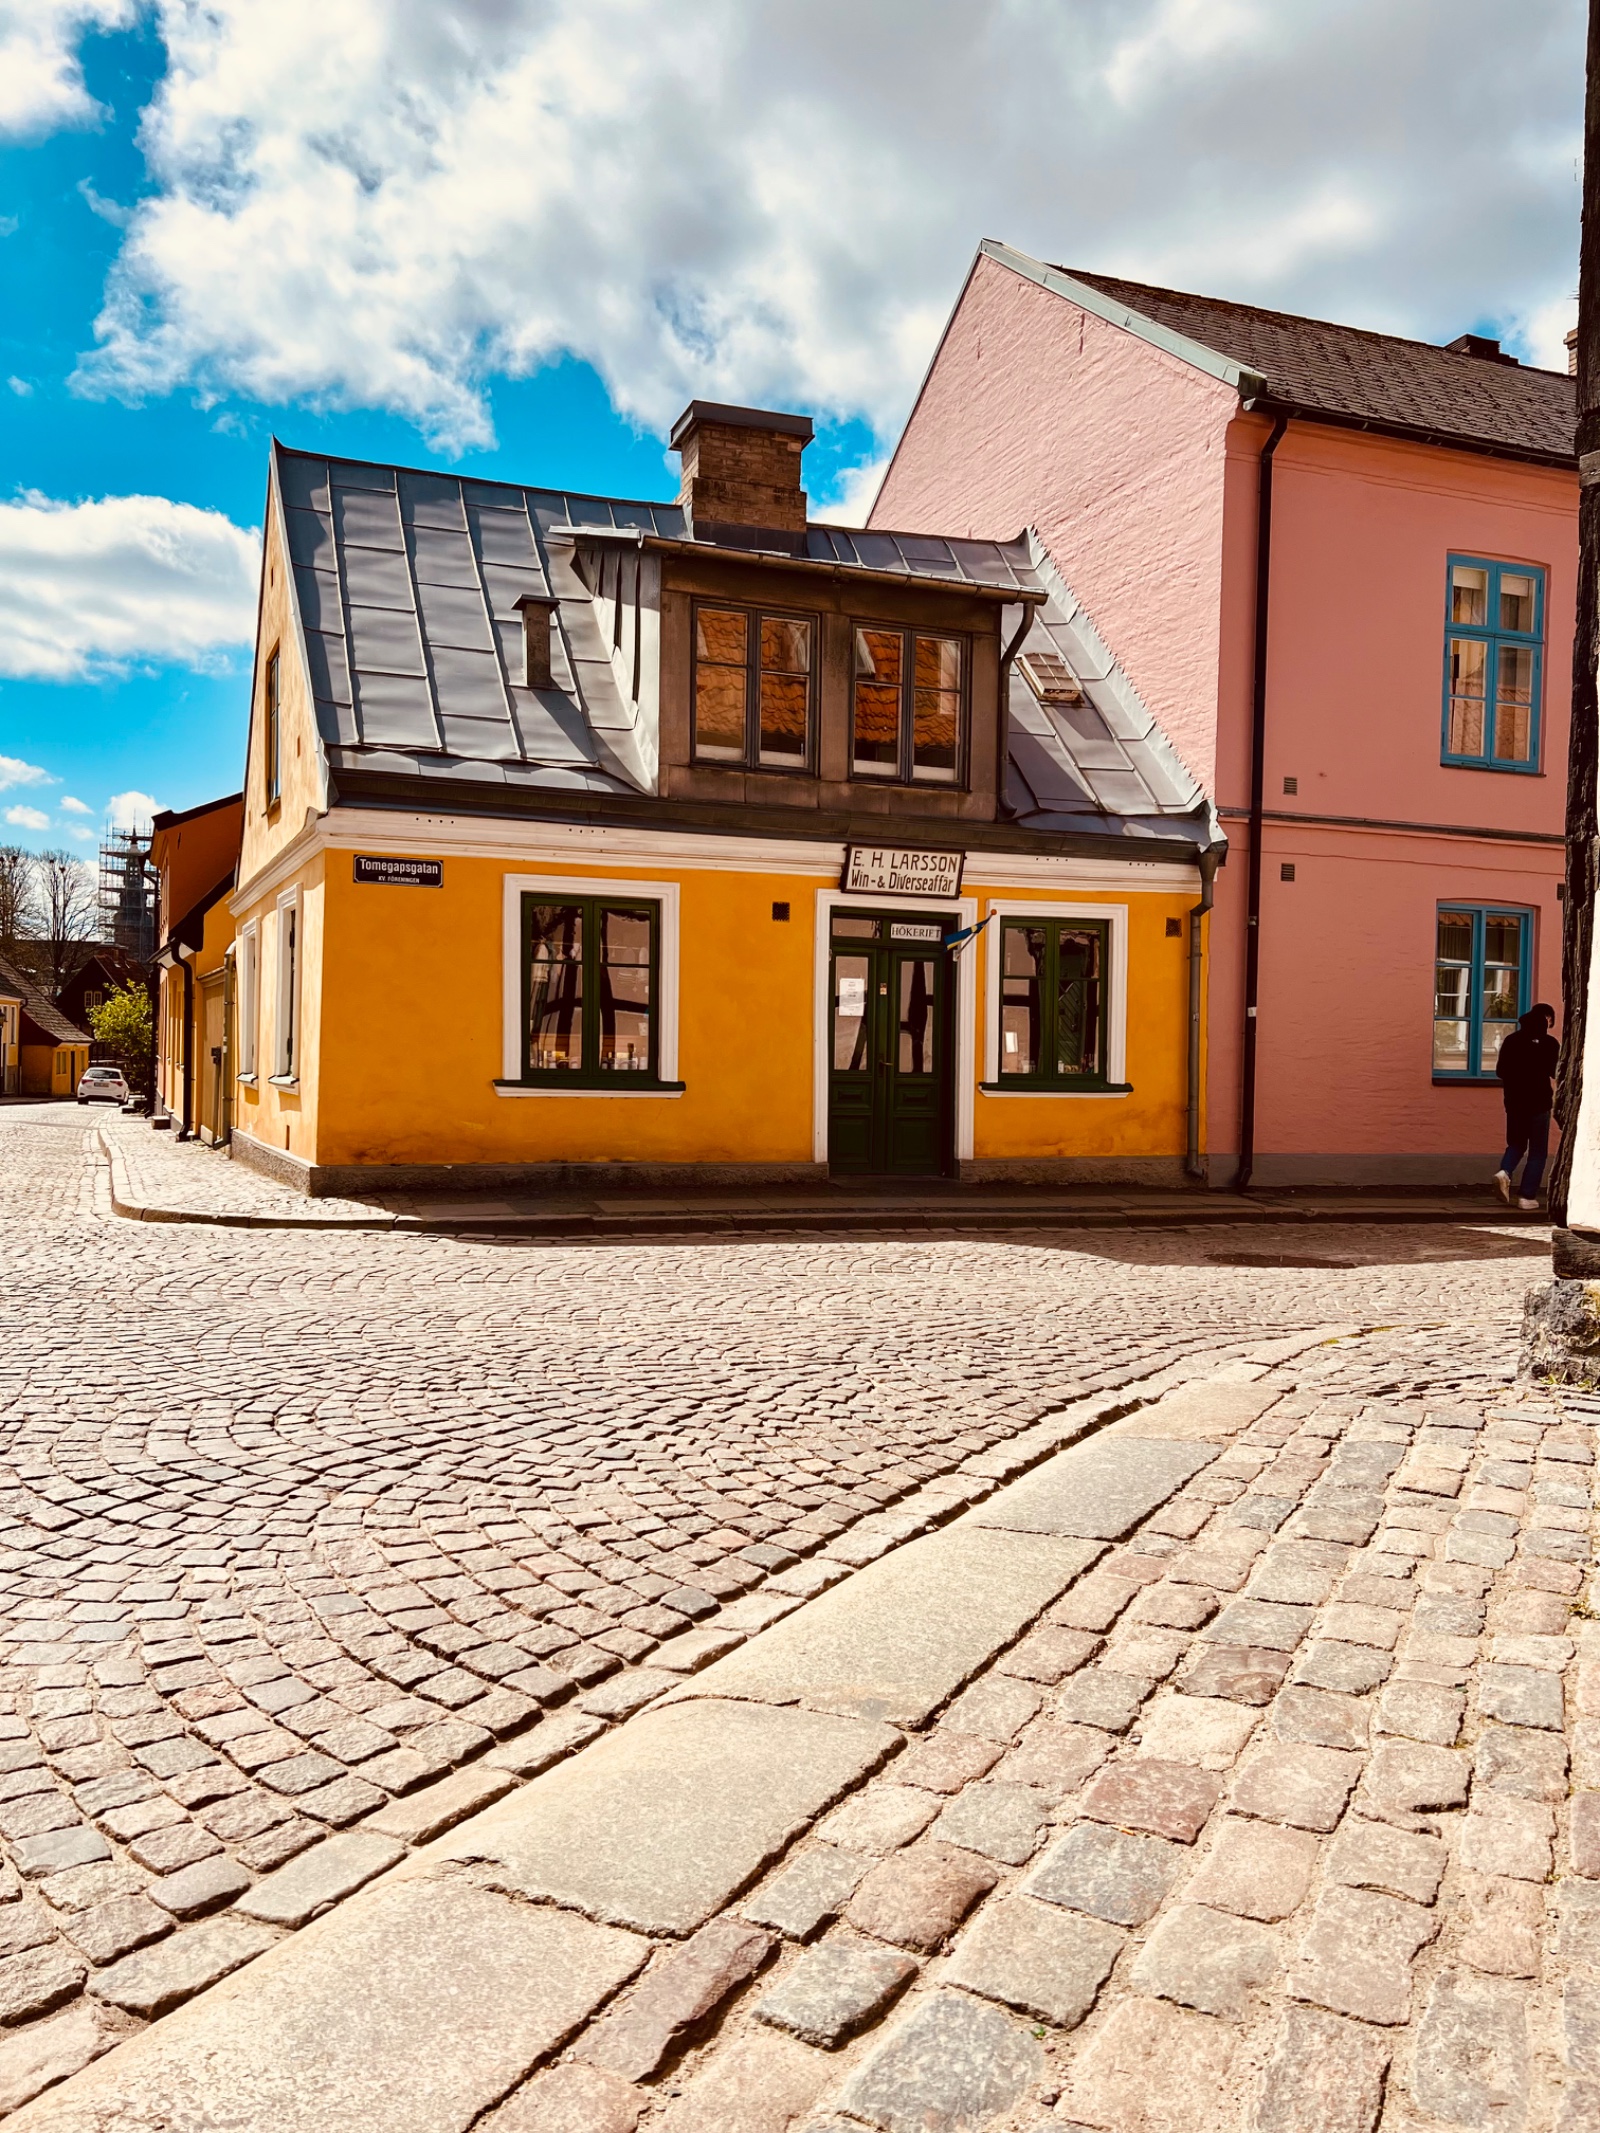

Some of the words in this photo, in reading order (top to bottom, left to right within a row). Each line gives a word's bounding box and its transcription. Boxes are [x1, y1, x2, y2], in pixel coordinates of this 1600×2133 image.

[360, 858, 438, 875] Tomegapsgatan
[853, 850, 865, 867] E.
[871, 851, 884, 868] H.
[891, 853, 957, 873] LARSSON
[889, 872, 954, 893] Diverseaffär
[891, 926, 941, 938] HÖKERIET
